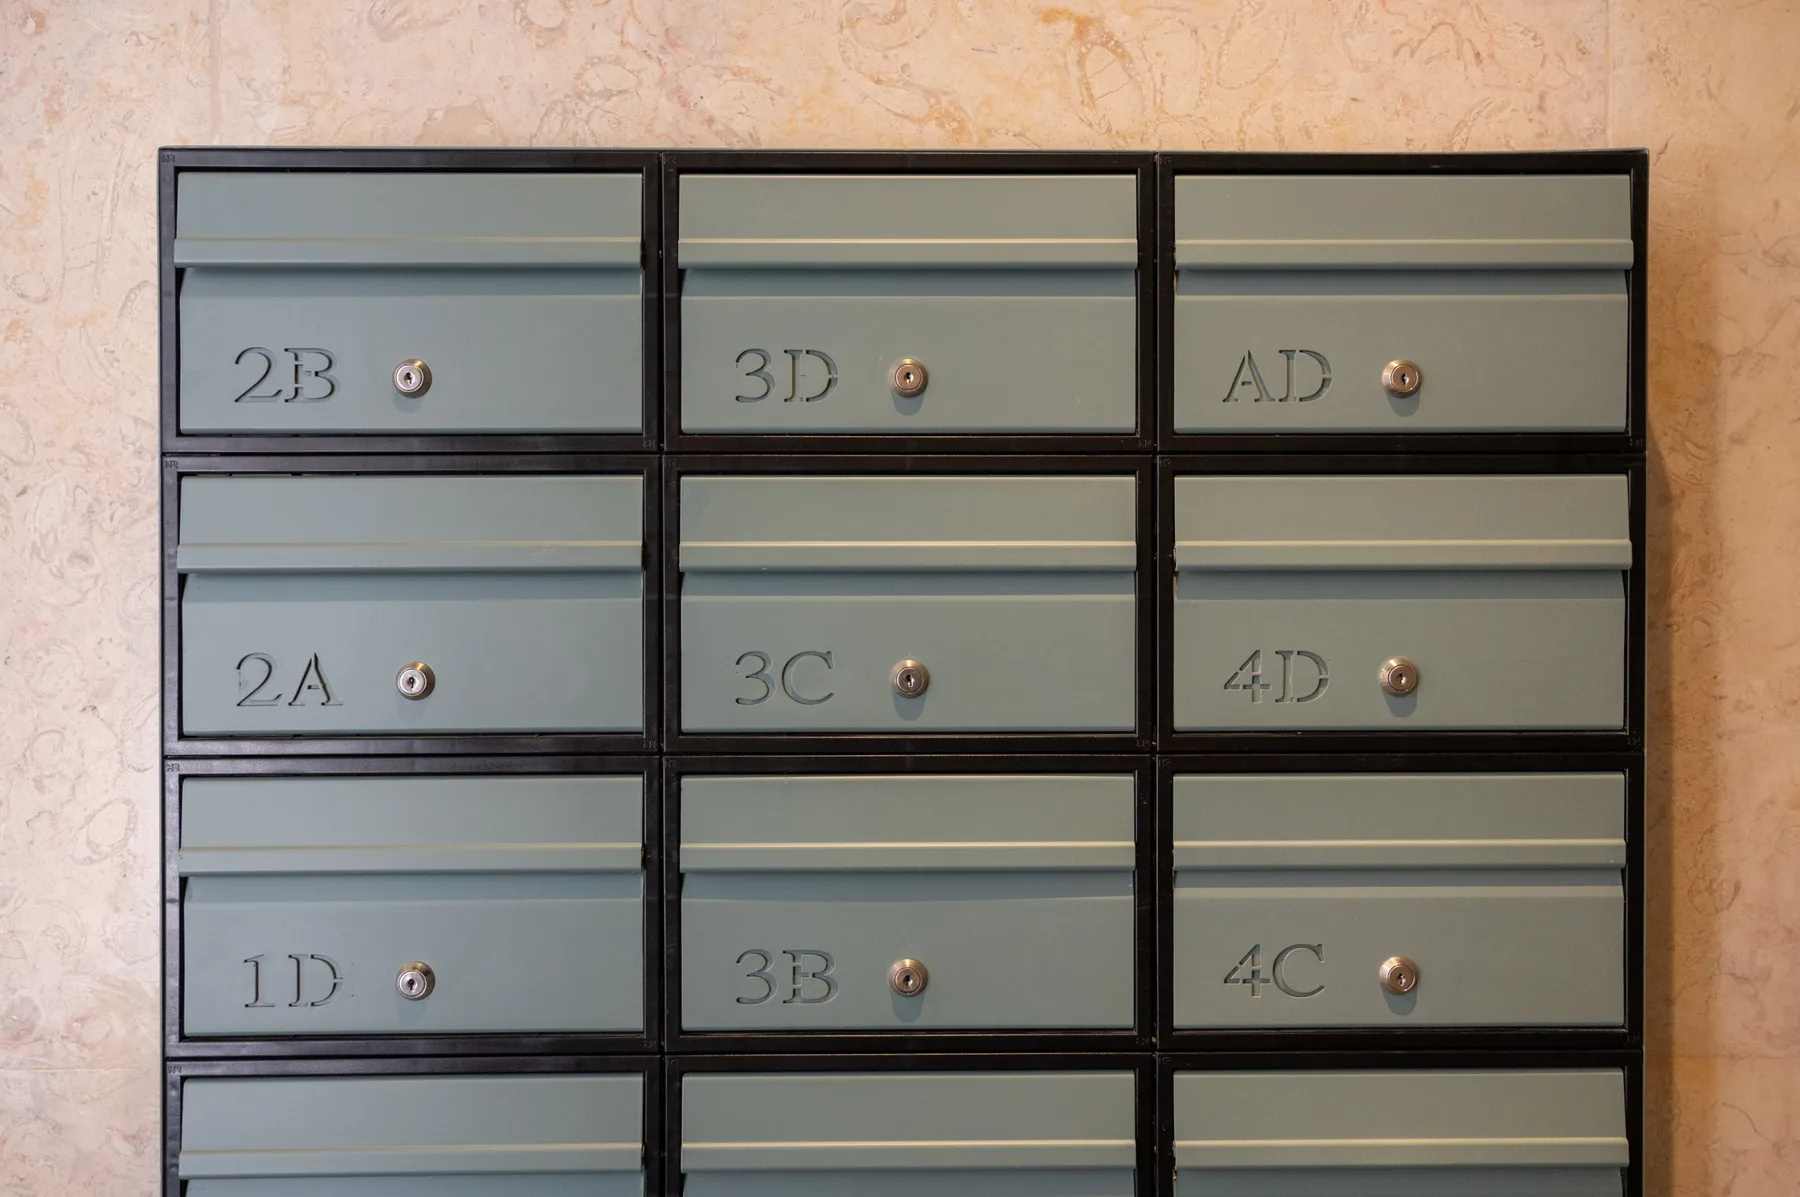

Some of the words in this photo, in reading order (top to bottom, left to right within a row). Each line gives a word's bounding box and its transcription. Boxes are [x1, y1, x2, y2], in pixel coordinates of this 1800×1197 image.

[234, 347, 341, 403] 2B
[735, 348, 839, 403] 3D
[1222, 349, 1332, 403] AD
[235, 652, 344, 707] 2A
[735, 650, 835, 706] 3C
[1223, 649, 1330, 704] 4D
[243, 953, 344, 1008] 1D
[735, 948, 840, 1005] 3B
[1223, 943, 1326, 999] 4C
